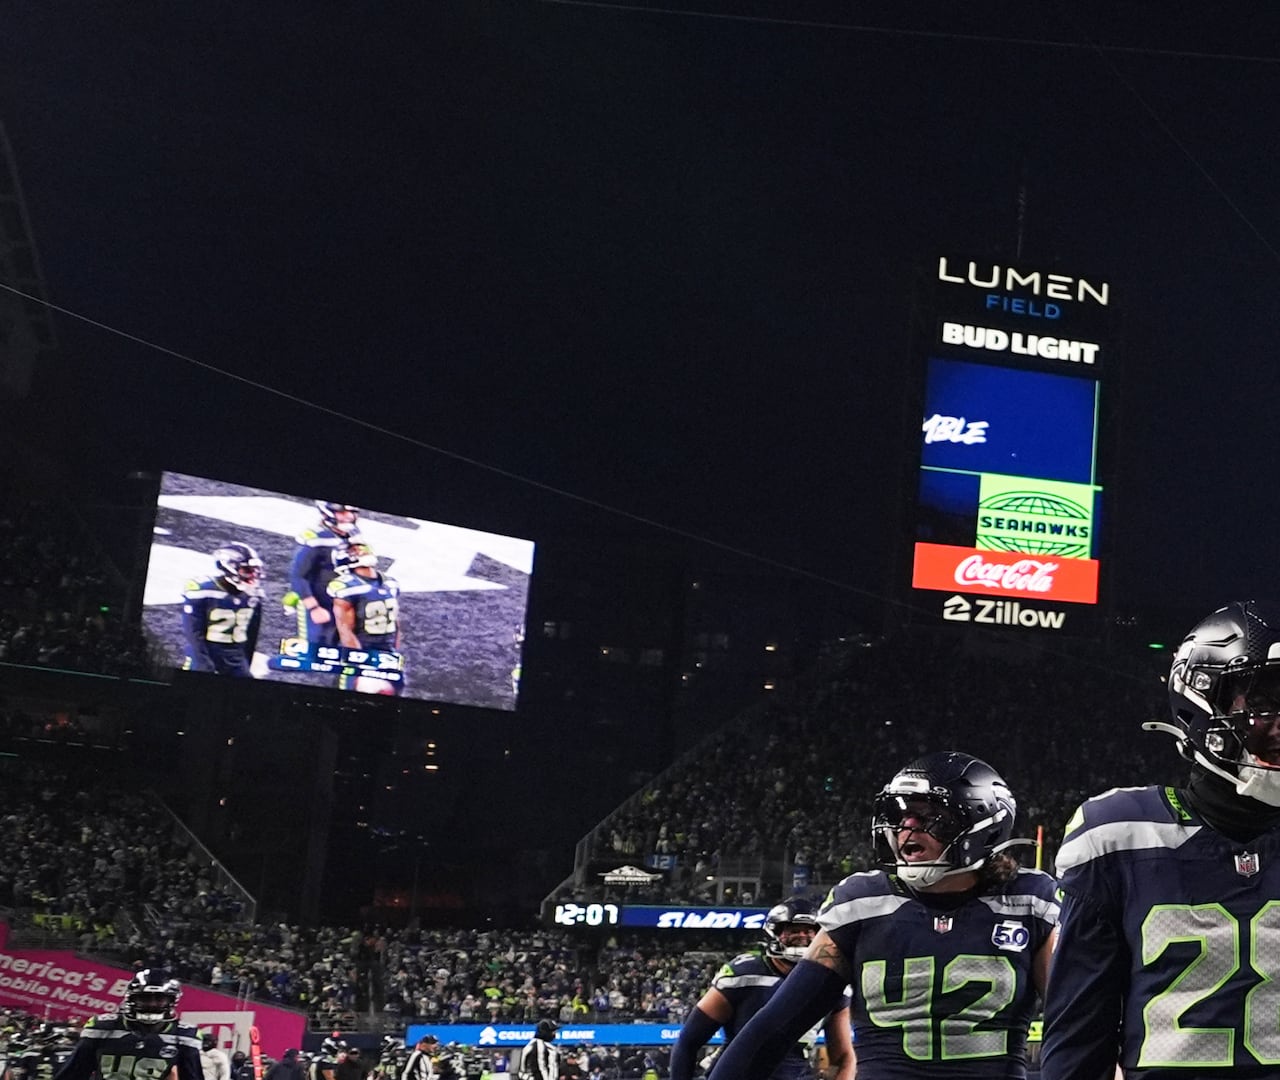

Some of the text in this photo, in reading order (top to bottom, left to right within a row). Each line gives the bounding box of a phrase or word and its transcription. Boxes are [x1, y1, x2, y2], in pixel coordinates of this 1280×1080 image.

[938, 257, 1109, 306] LUMEN
[986, 294, 1062, 320] FIELD
[942, 322, 1099, 364] BUD LIGHT
[979, 515, 1090, 538] SEAHAWKS
[954, 554, 1060, 593] Coca-Cola
[974, 599, 1067, 629] Zillow
[554, 903, 619, 926] 12:07
[992, 924, 1030, 948] 50
[0, 972, 50, 996] obile
[50, 986, 120, 1014] Netwo
[861, 955, 1017, 1060] 42
[562, 1030, 595, 1041] BANK
